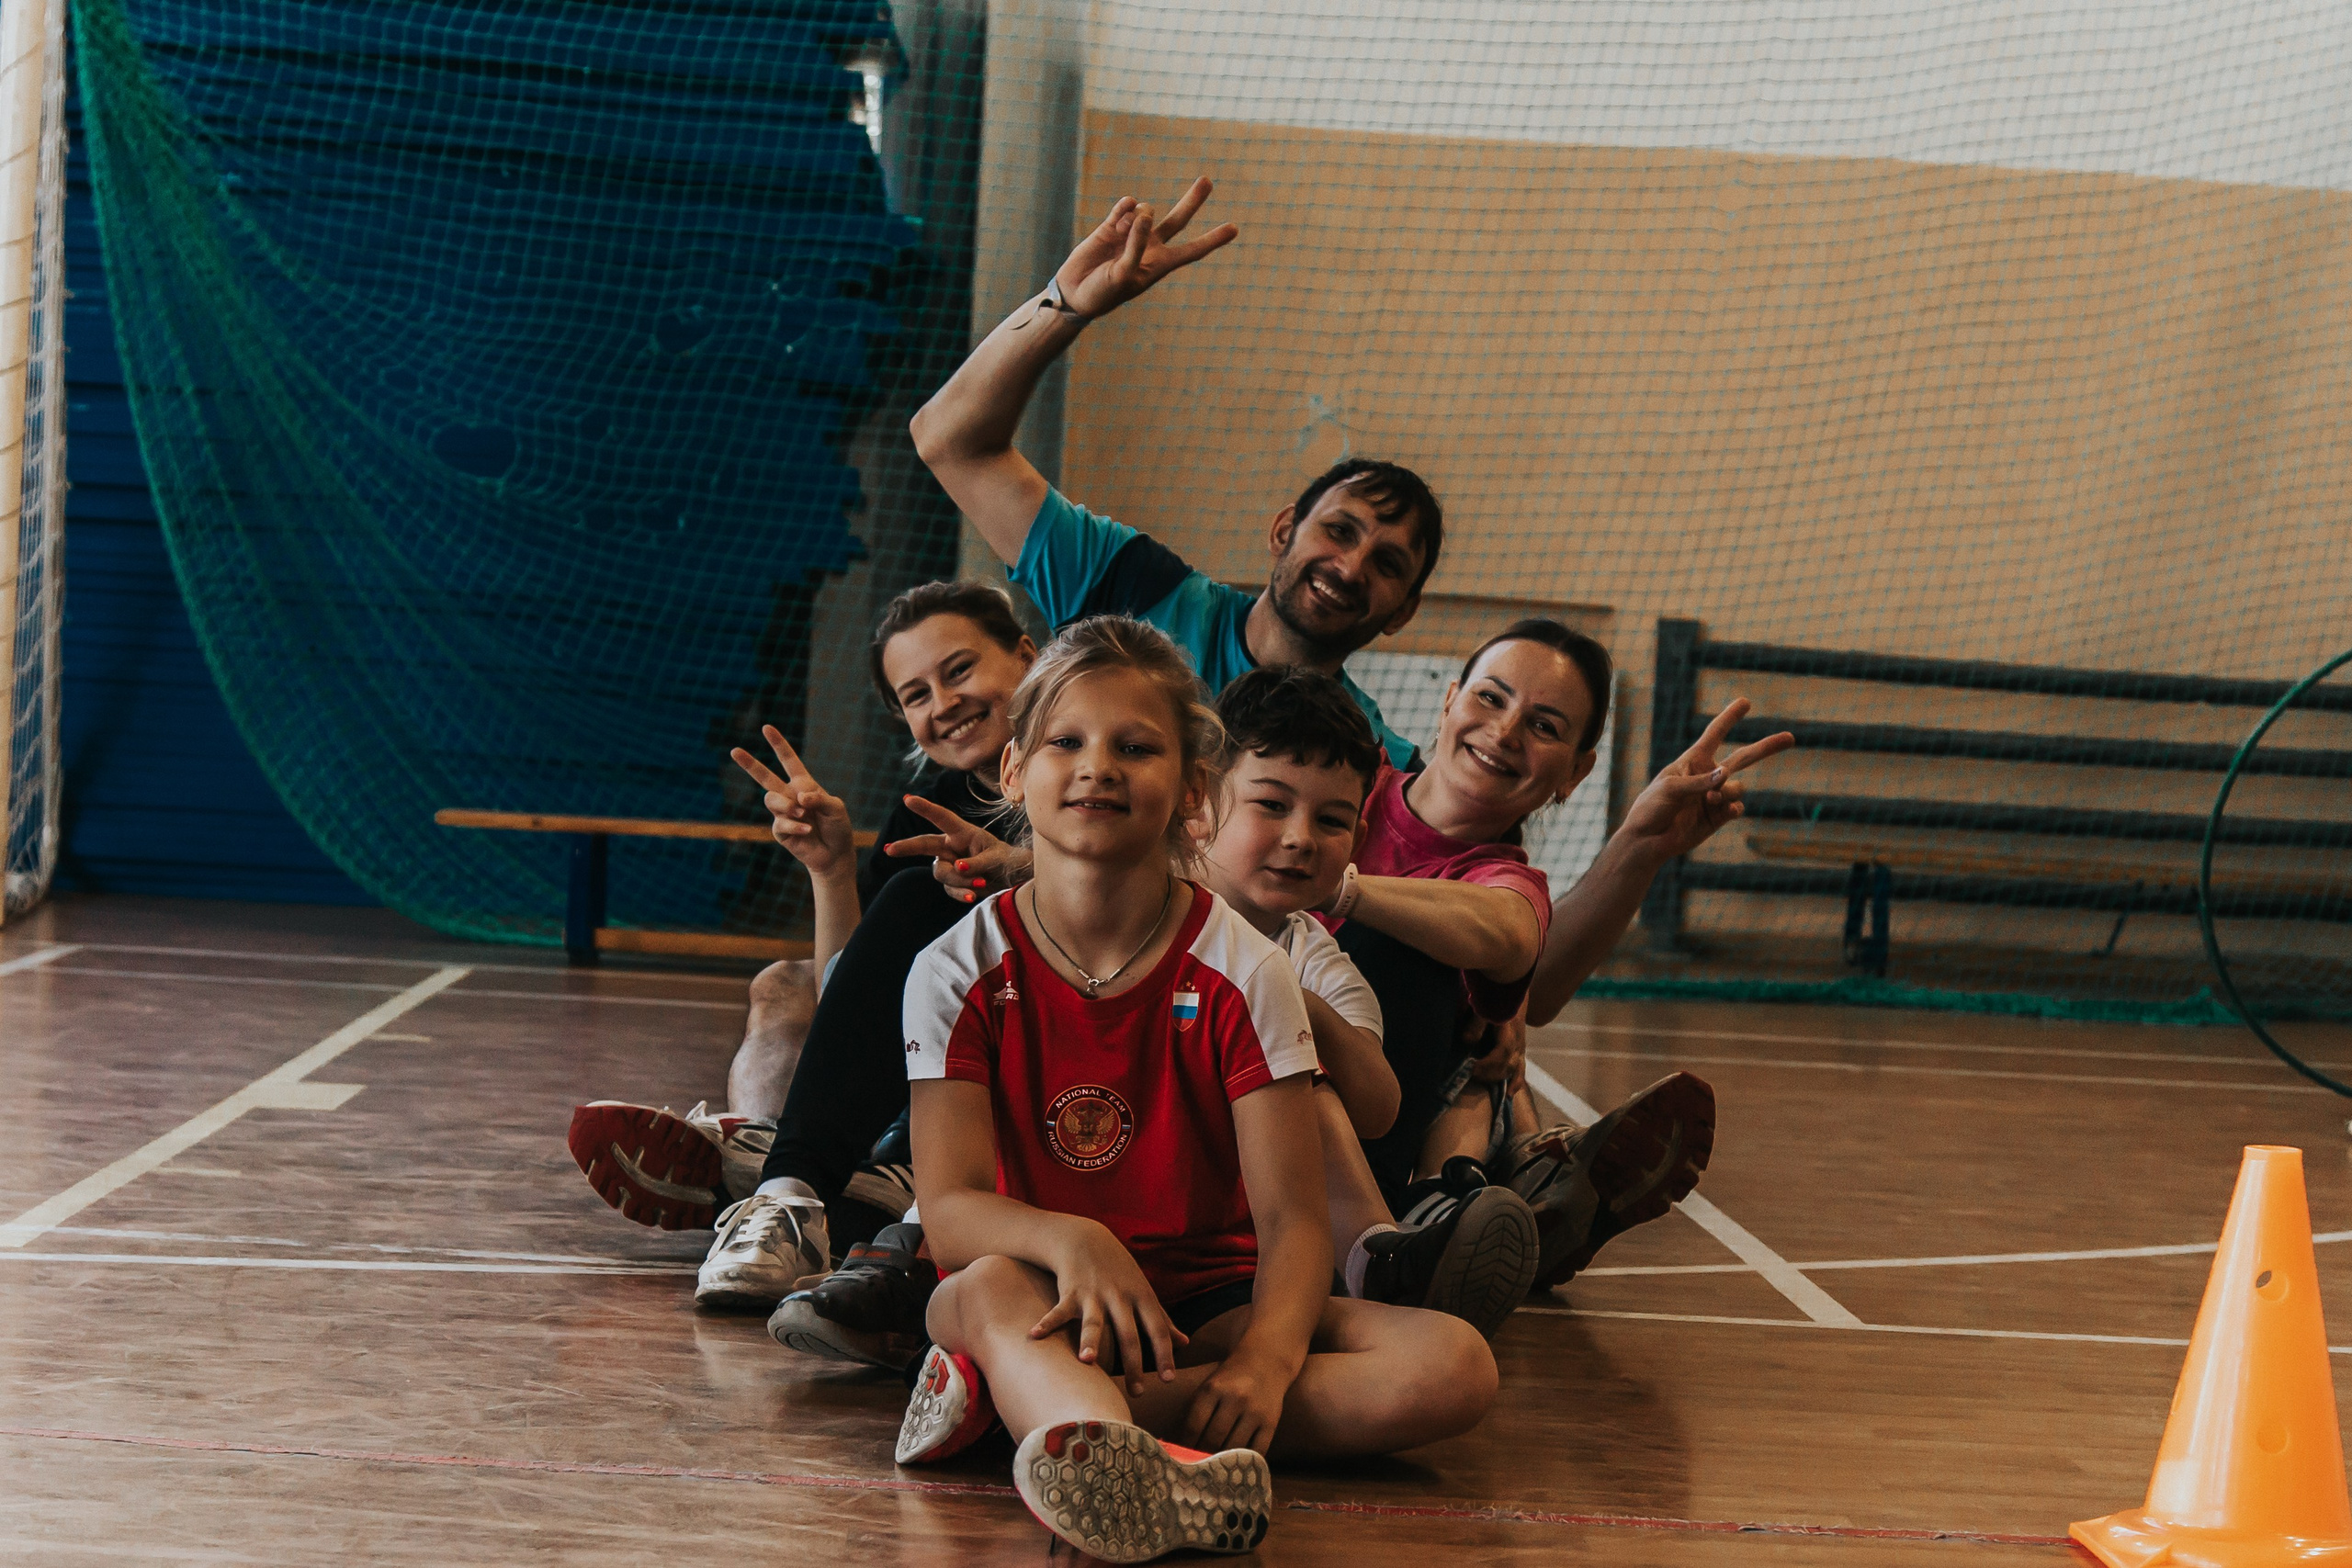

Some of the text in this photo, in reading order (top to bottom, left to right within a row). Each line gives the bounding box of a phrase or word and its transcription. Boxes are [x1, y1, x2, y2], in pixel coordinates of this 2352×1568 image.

[1056, 1089, 1101, 1109] NATIONAL
[1048, 1131, 1127, 1168] RUSSIAN FEDERATION
